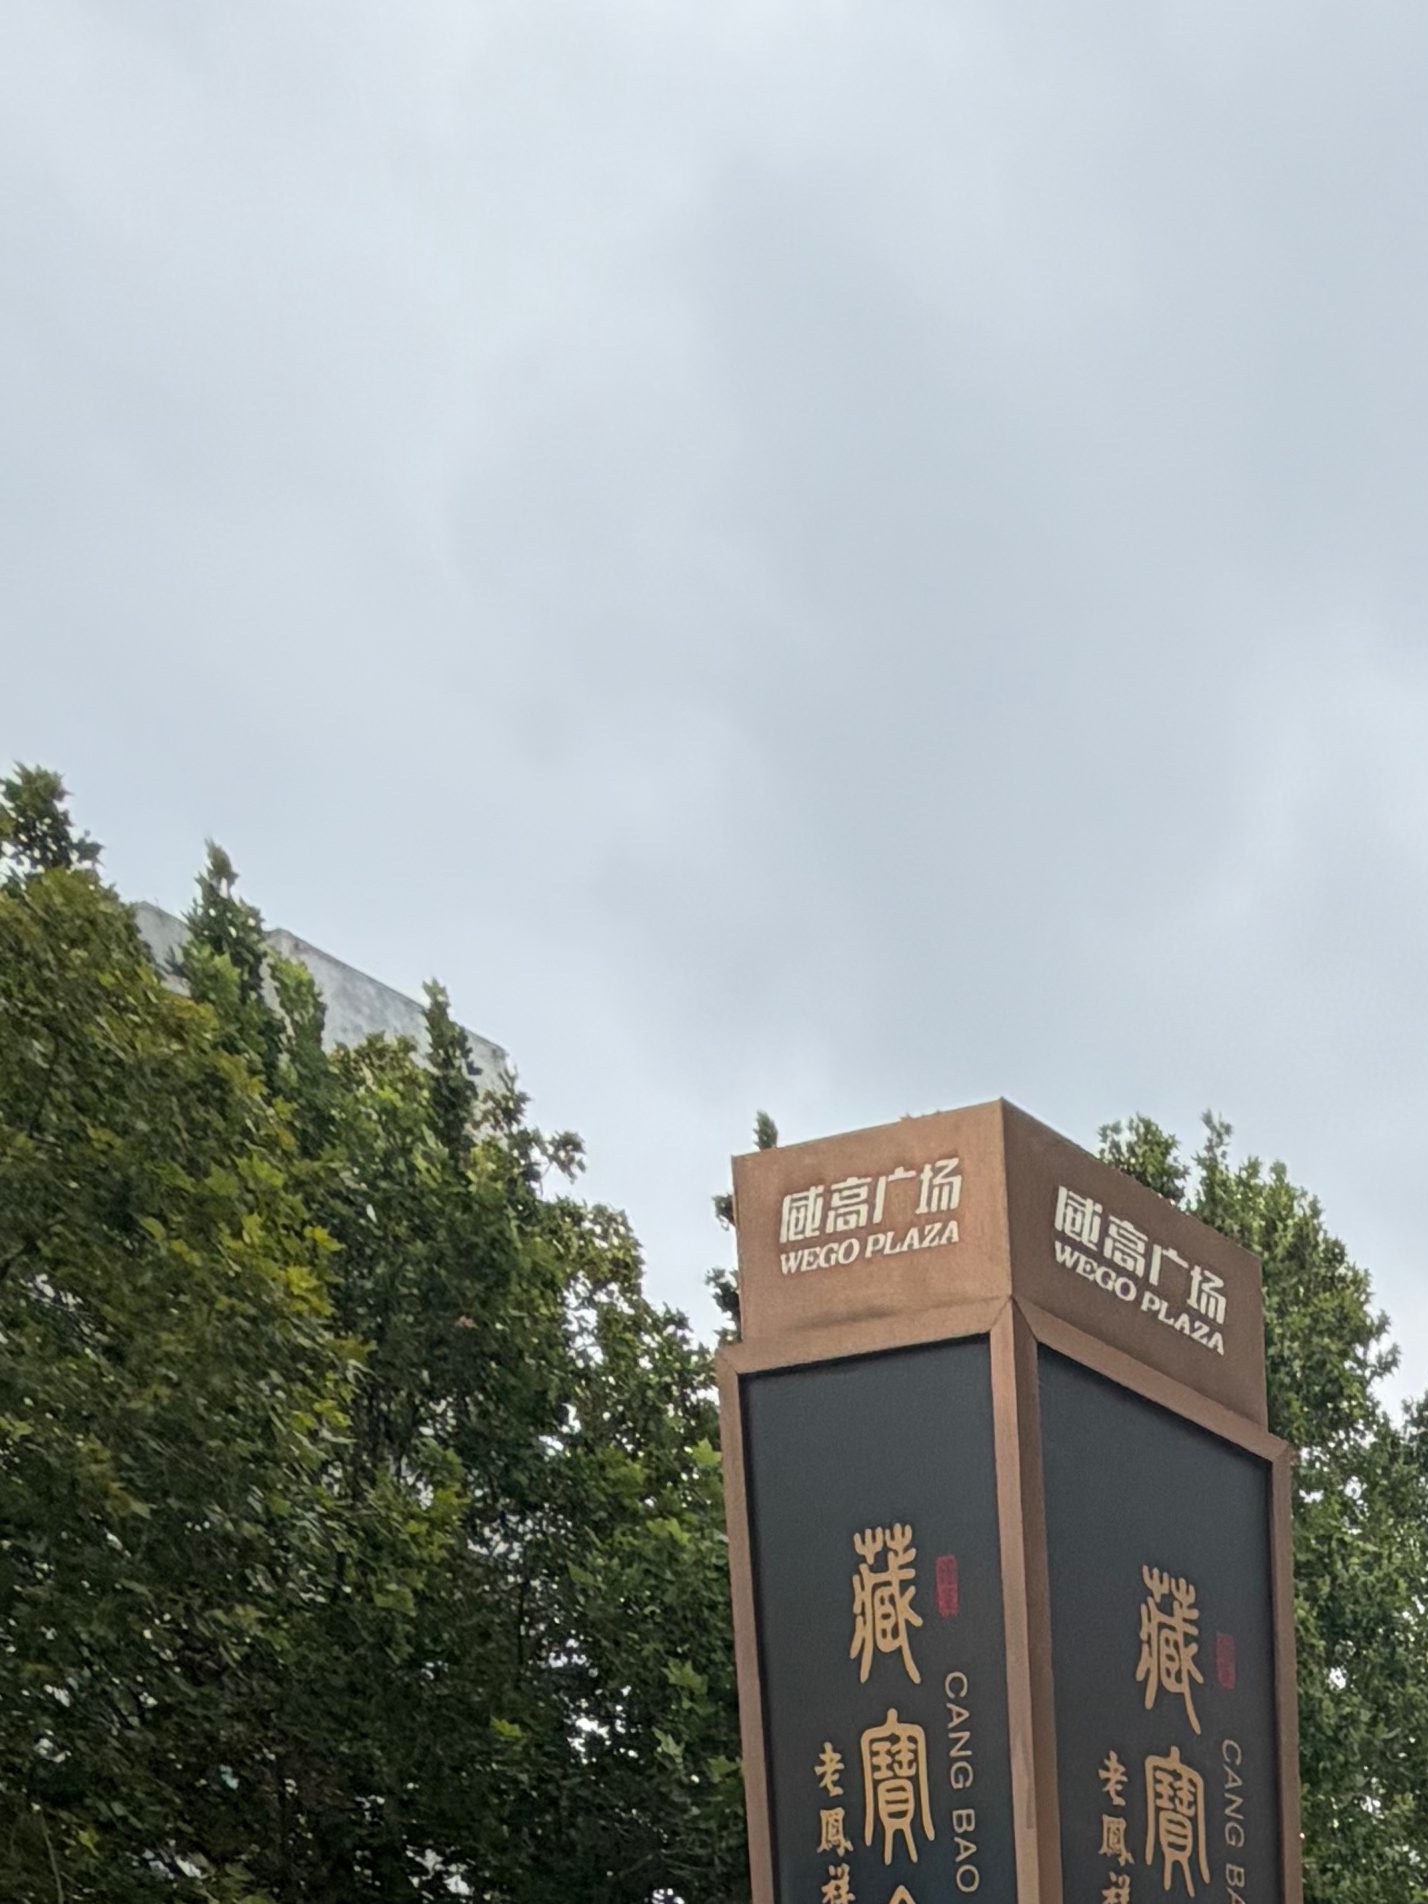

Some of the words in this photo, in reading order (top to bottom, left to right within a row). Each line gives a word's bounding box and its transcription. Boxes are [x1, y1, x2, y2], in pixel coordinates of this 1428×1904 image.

[779, 1240, 860, 1276] WEGO
[864, 1219, 960, 1260] PLAZA
[780, 1157, 963, 1243] 威高广场
[1053, 1184, 1228, 1326] 威高广场
[1053, 1239, 1137, 1302] WEGO
[1140, 1289, 1226, 1356] PLAZA
[944, 1670, 975, 1791] CANG
[1221, 1739, 1247, 1849] CANG
[951, 1808, 981, 1893] BAO
